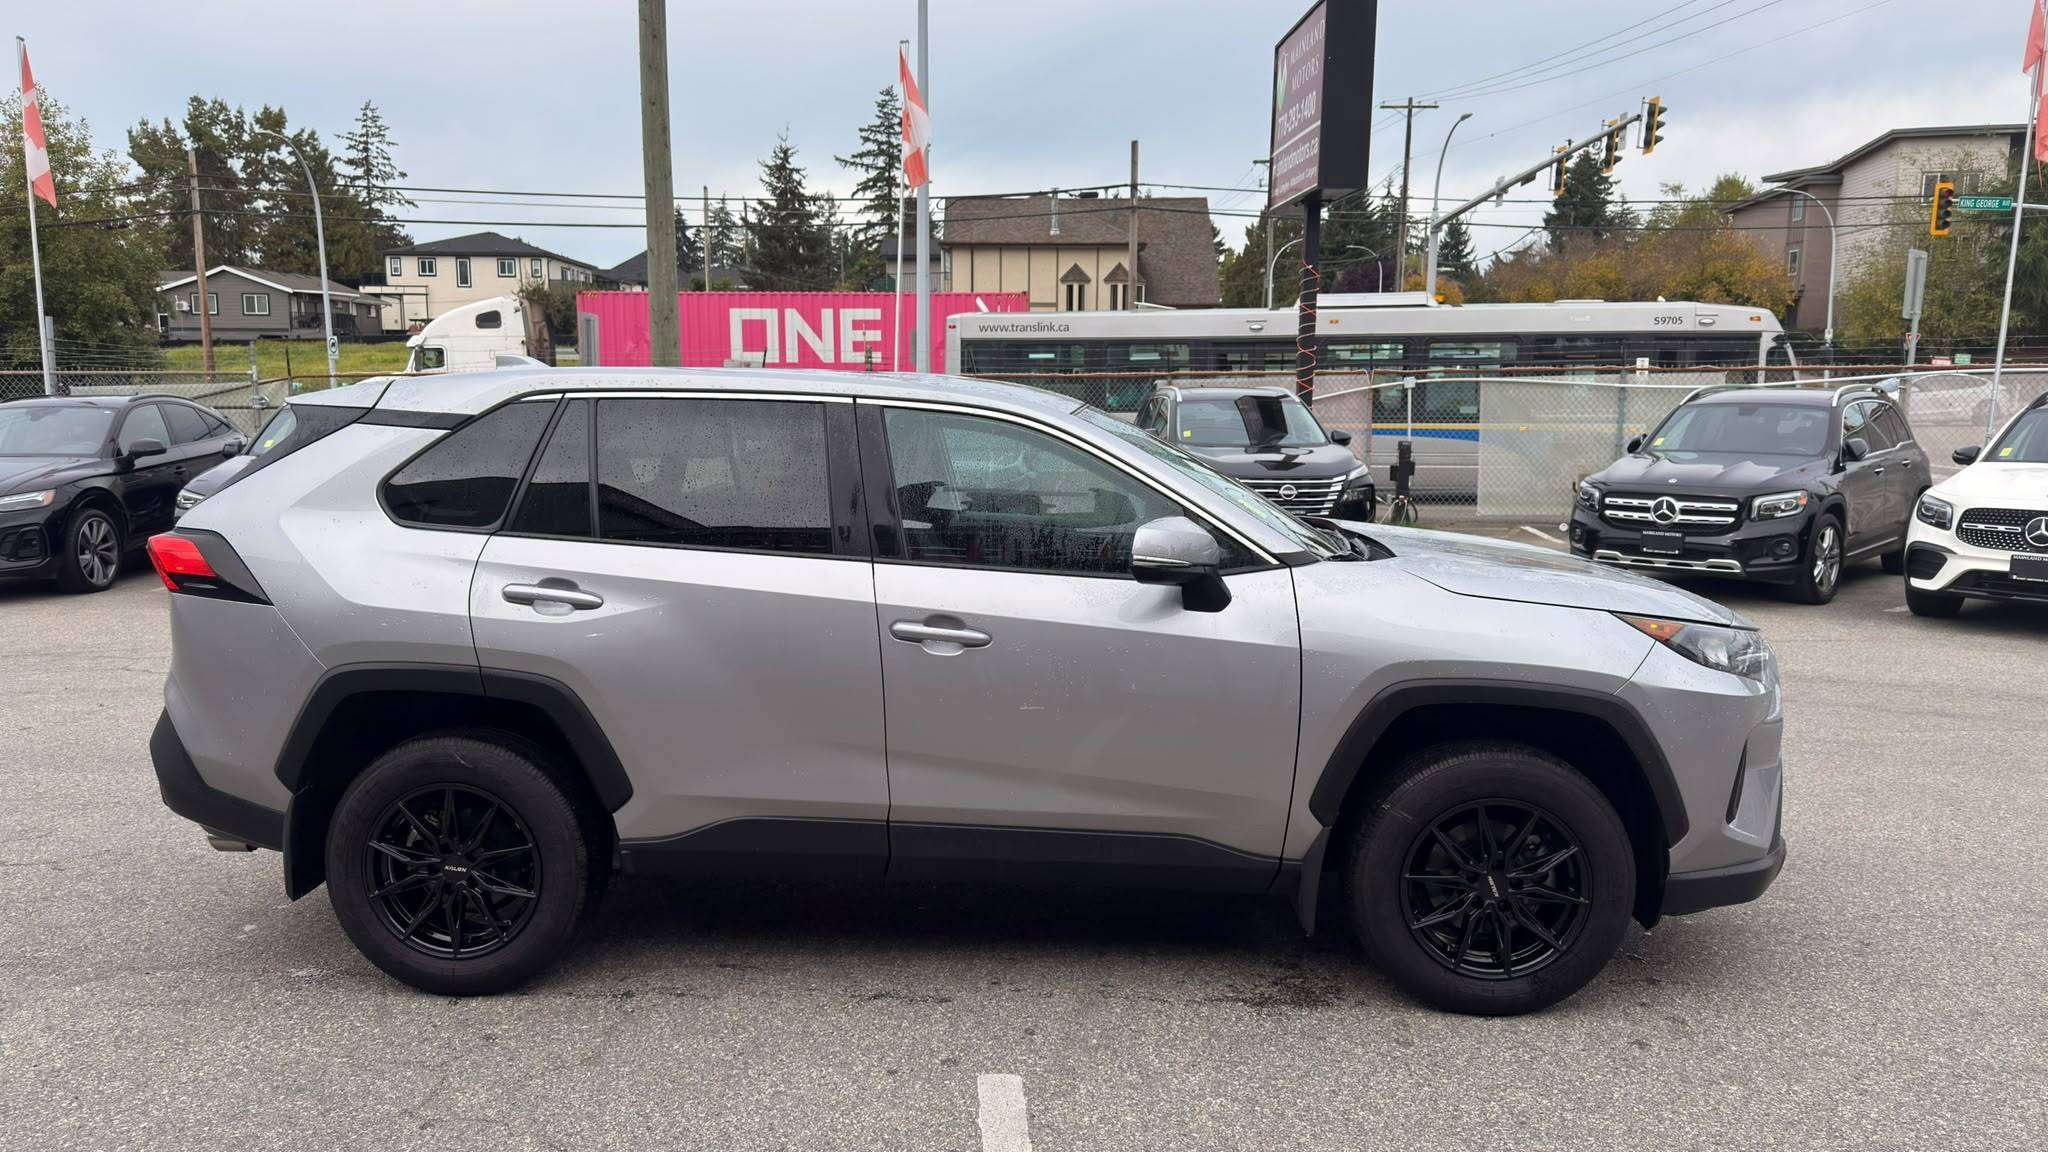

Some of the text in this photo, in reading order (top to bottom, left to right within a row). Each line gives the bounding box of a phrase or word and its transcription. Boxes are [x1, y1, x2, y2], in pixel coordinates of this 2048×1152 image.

[1290, 19, 1326, 65] MAINLAND
[1292, 54, 1320, 91] MOTORS
[1960, 199, 1975, 208] KING
[1976, 199, 2000, 208] GEORGE
[979, 322, 1070, 333] www.translink.ca
[1654, 317, 1683, 325] S9705
[730, 307, 882, 364] ONE
